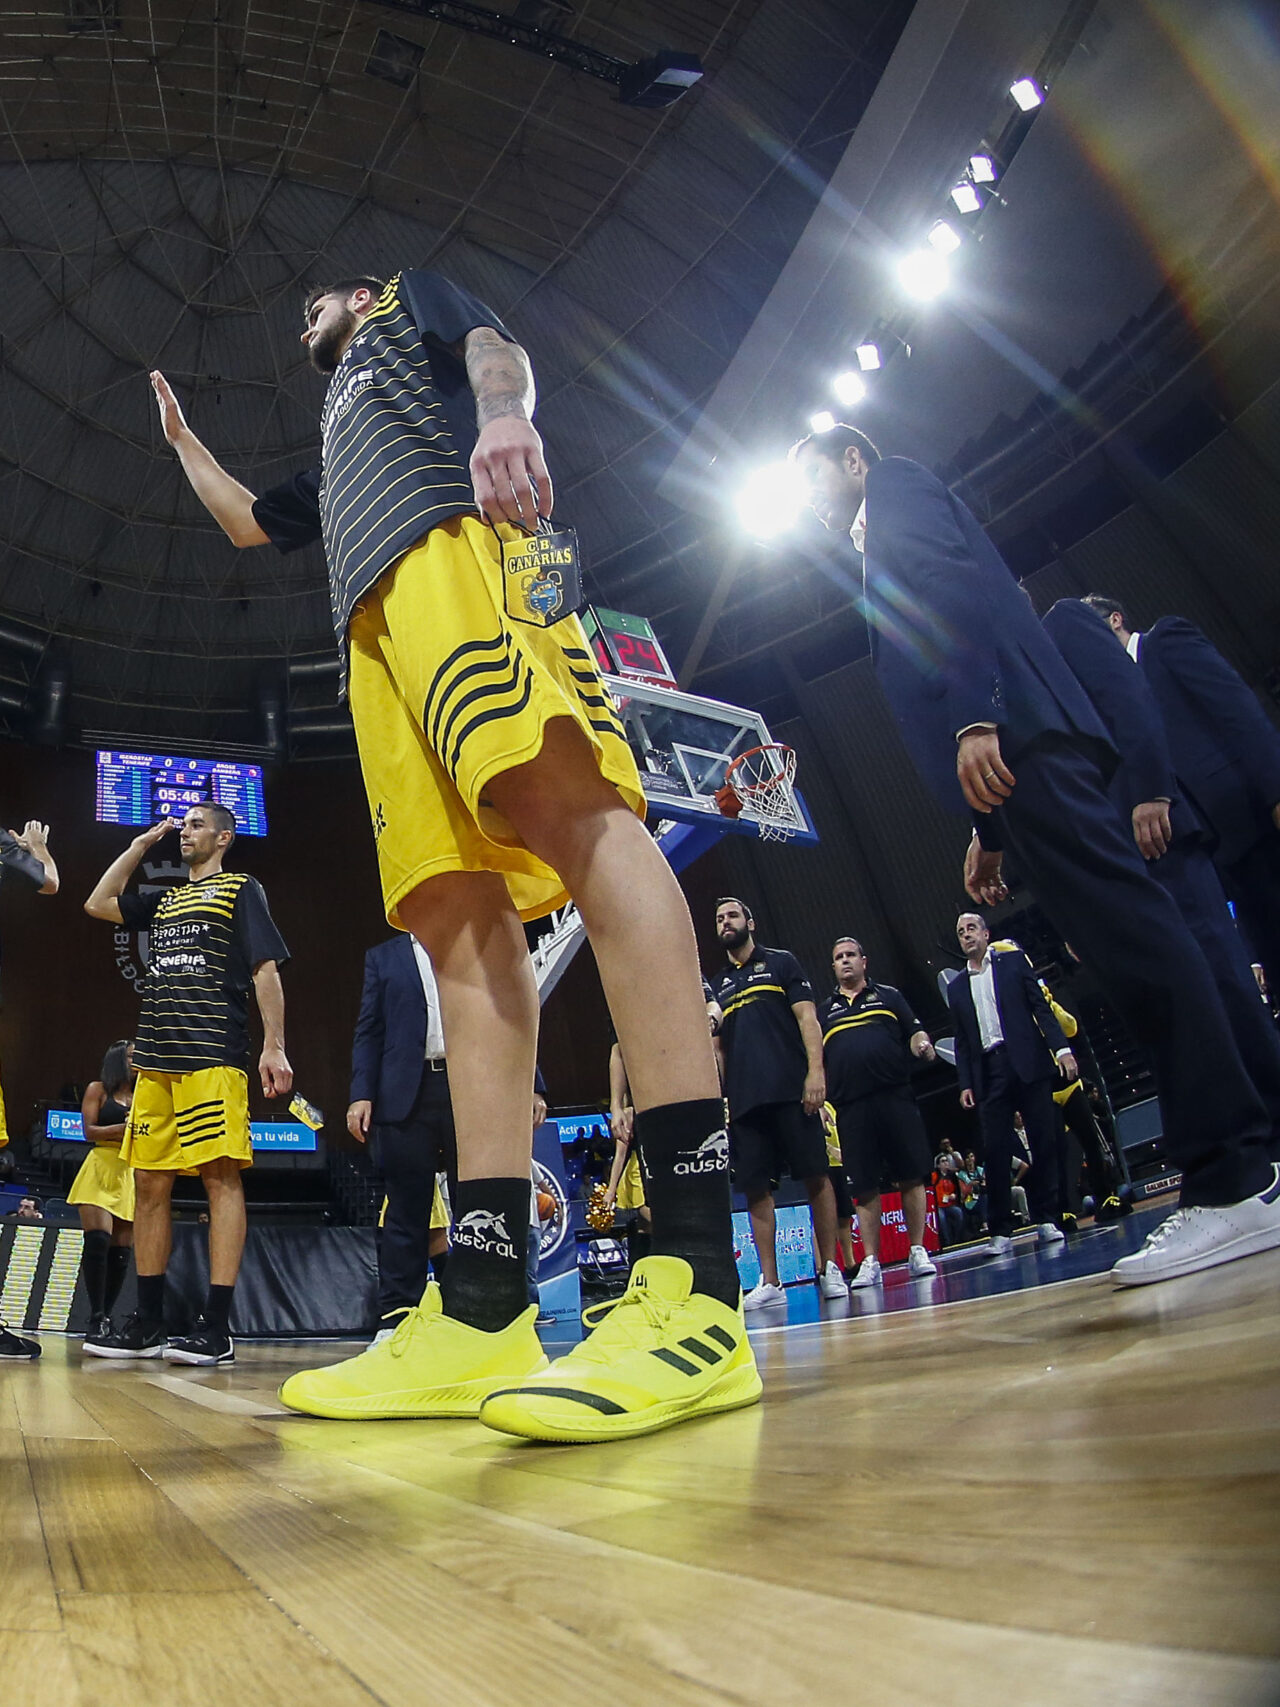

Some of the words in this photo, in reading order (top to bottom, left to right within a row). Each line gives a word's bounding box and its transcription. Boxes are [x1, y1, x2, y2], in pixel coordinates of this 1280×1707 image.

[508, 547, 572, 574] CANARIAS
[613, 633, 664, 673] 24
[165, 758, 173, 767] 0
[189, 760, 197, 770] 0
[158, 788, 200, 803] 05:46
[160, 803, 170, 814] 0
[61, 1118, 82, 1130] DX
[265, 1132, 276, 1141] tu
[278, 1131, 299, 1142] vida
[673, 1159, 729, 1175] aust
